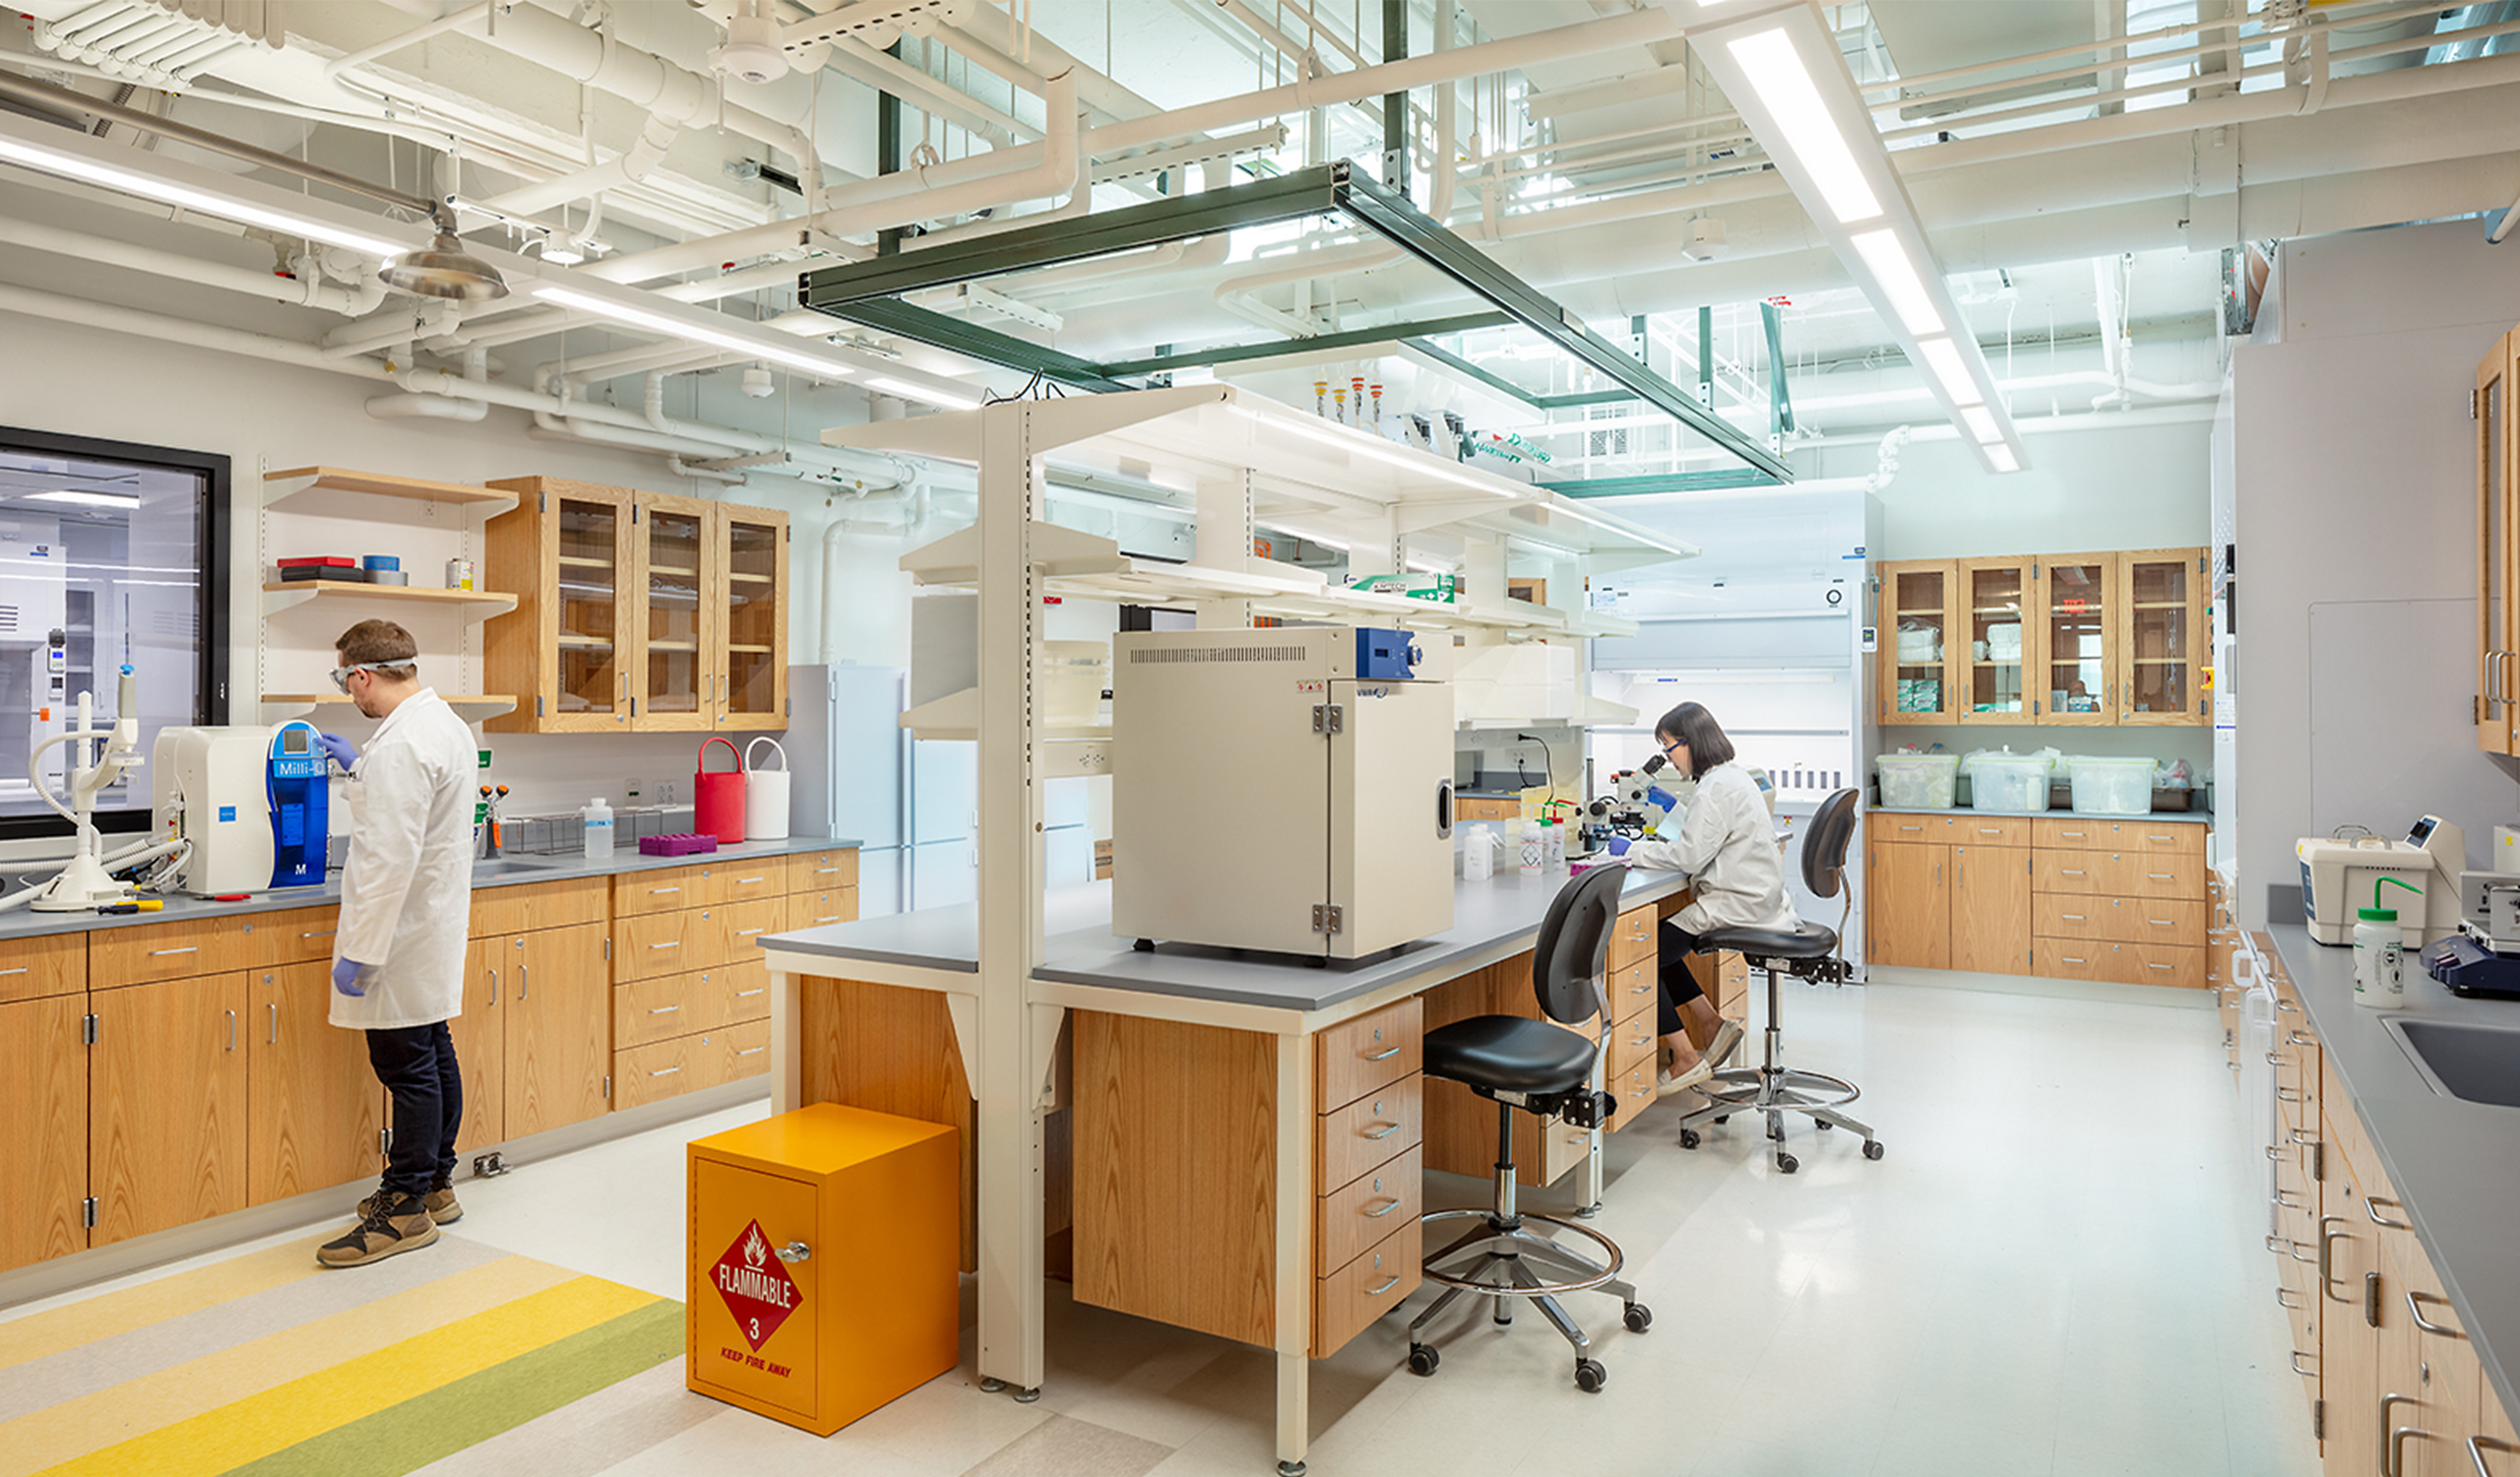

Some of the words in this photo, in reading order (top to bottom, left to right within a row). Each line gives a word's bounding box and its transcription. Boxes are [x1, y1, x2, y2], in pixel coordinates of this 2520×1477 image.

[280, 761, 325, 776] Milli-Q
[294, 864, 306, 875] M
[720, 1263, 791, 1309] FLAMMABLE
[749, 1317, 760, 1340] 3
[720, 1346, 744, 1363] KEEP
[745, 1354, 766, 1371] FIRE
[767, 1362, 792, 1378] AWAY
